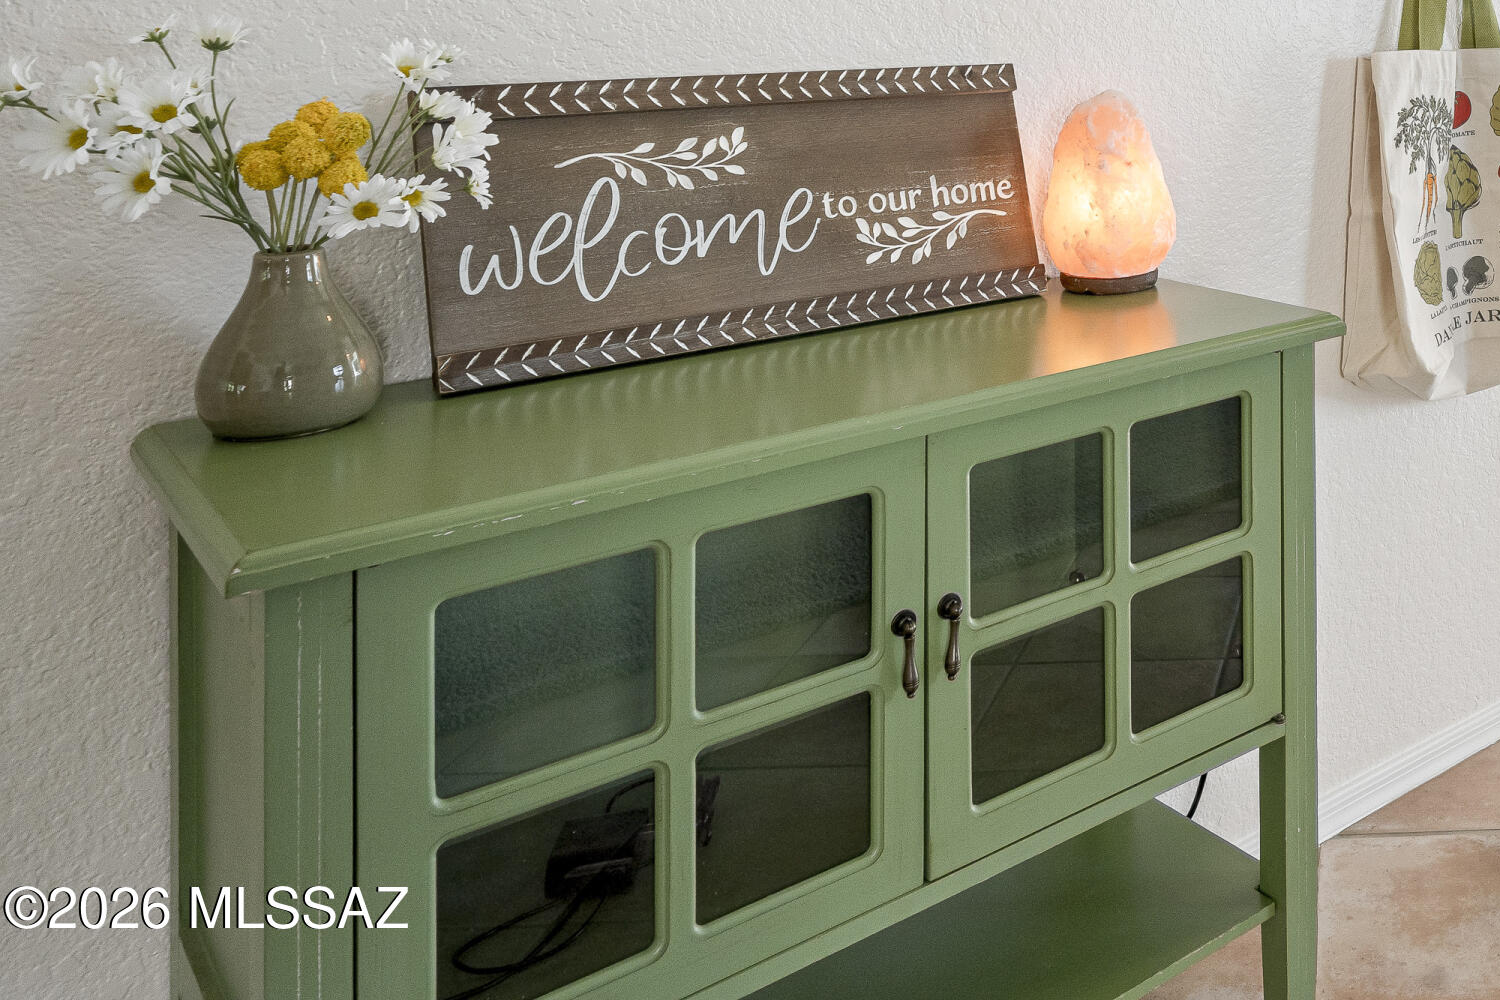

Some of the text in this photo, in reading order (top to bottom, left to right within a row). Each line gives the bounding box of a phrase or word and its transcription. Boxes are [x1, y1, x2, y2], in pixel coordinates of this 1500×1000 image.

[459, 174, 1015, 303] welcome to our home
